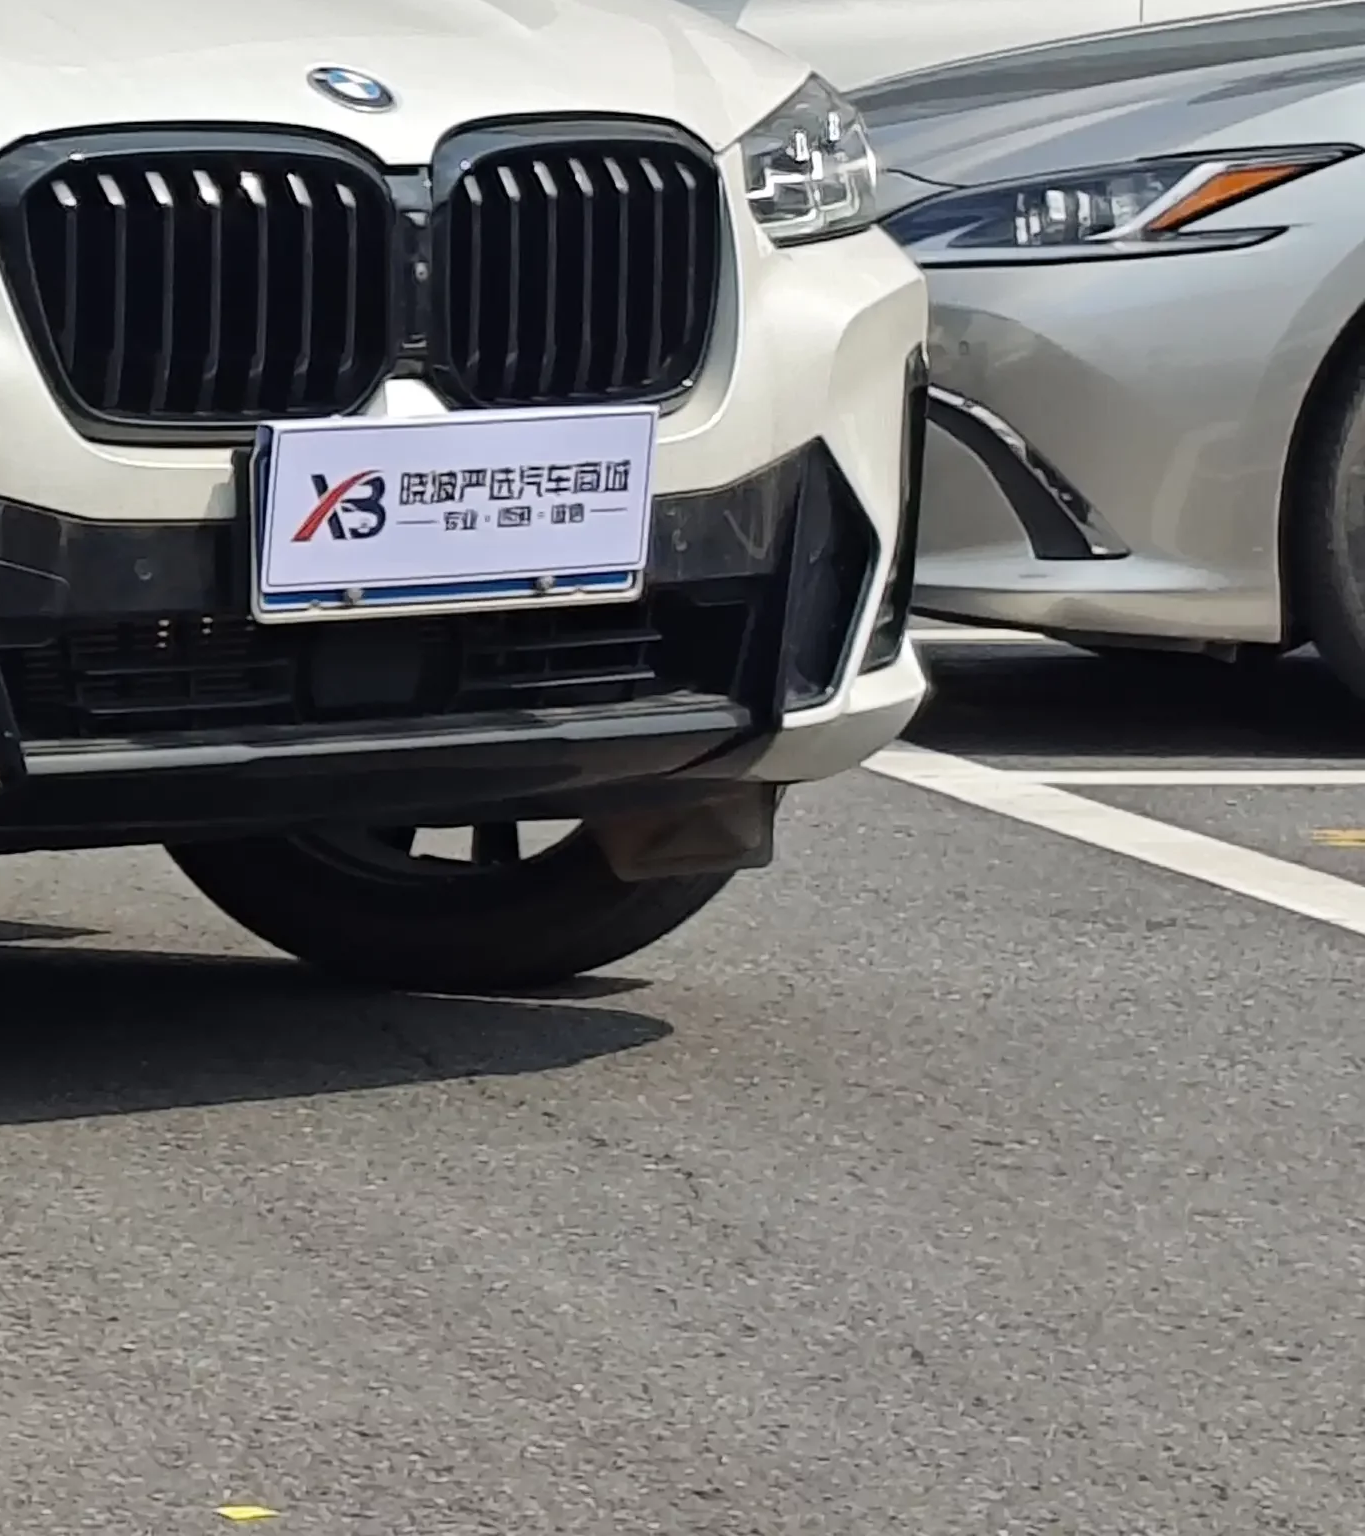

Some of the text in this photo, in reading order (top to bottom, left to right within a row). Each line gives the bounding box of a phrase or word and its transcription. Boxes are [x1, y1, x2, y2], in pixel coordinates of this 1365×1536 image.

[399, 460, 632, 505] 晓波严选汽车商城
